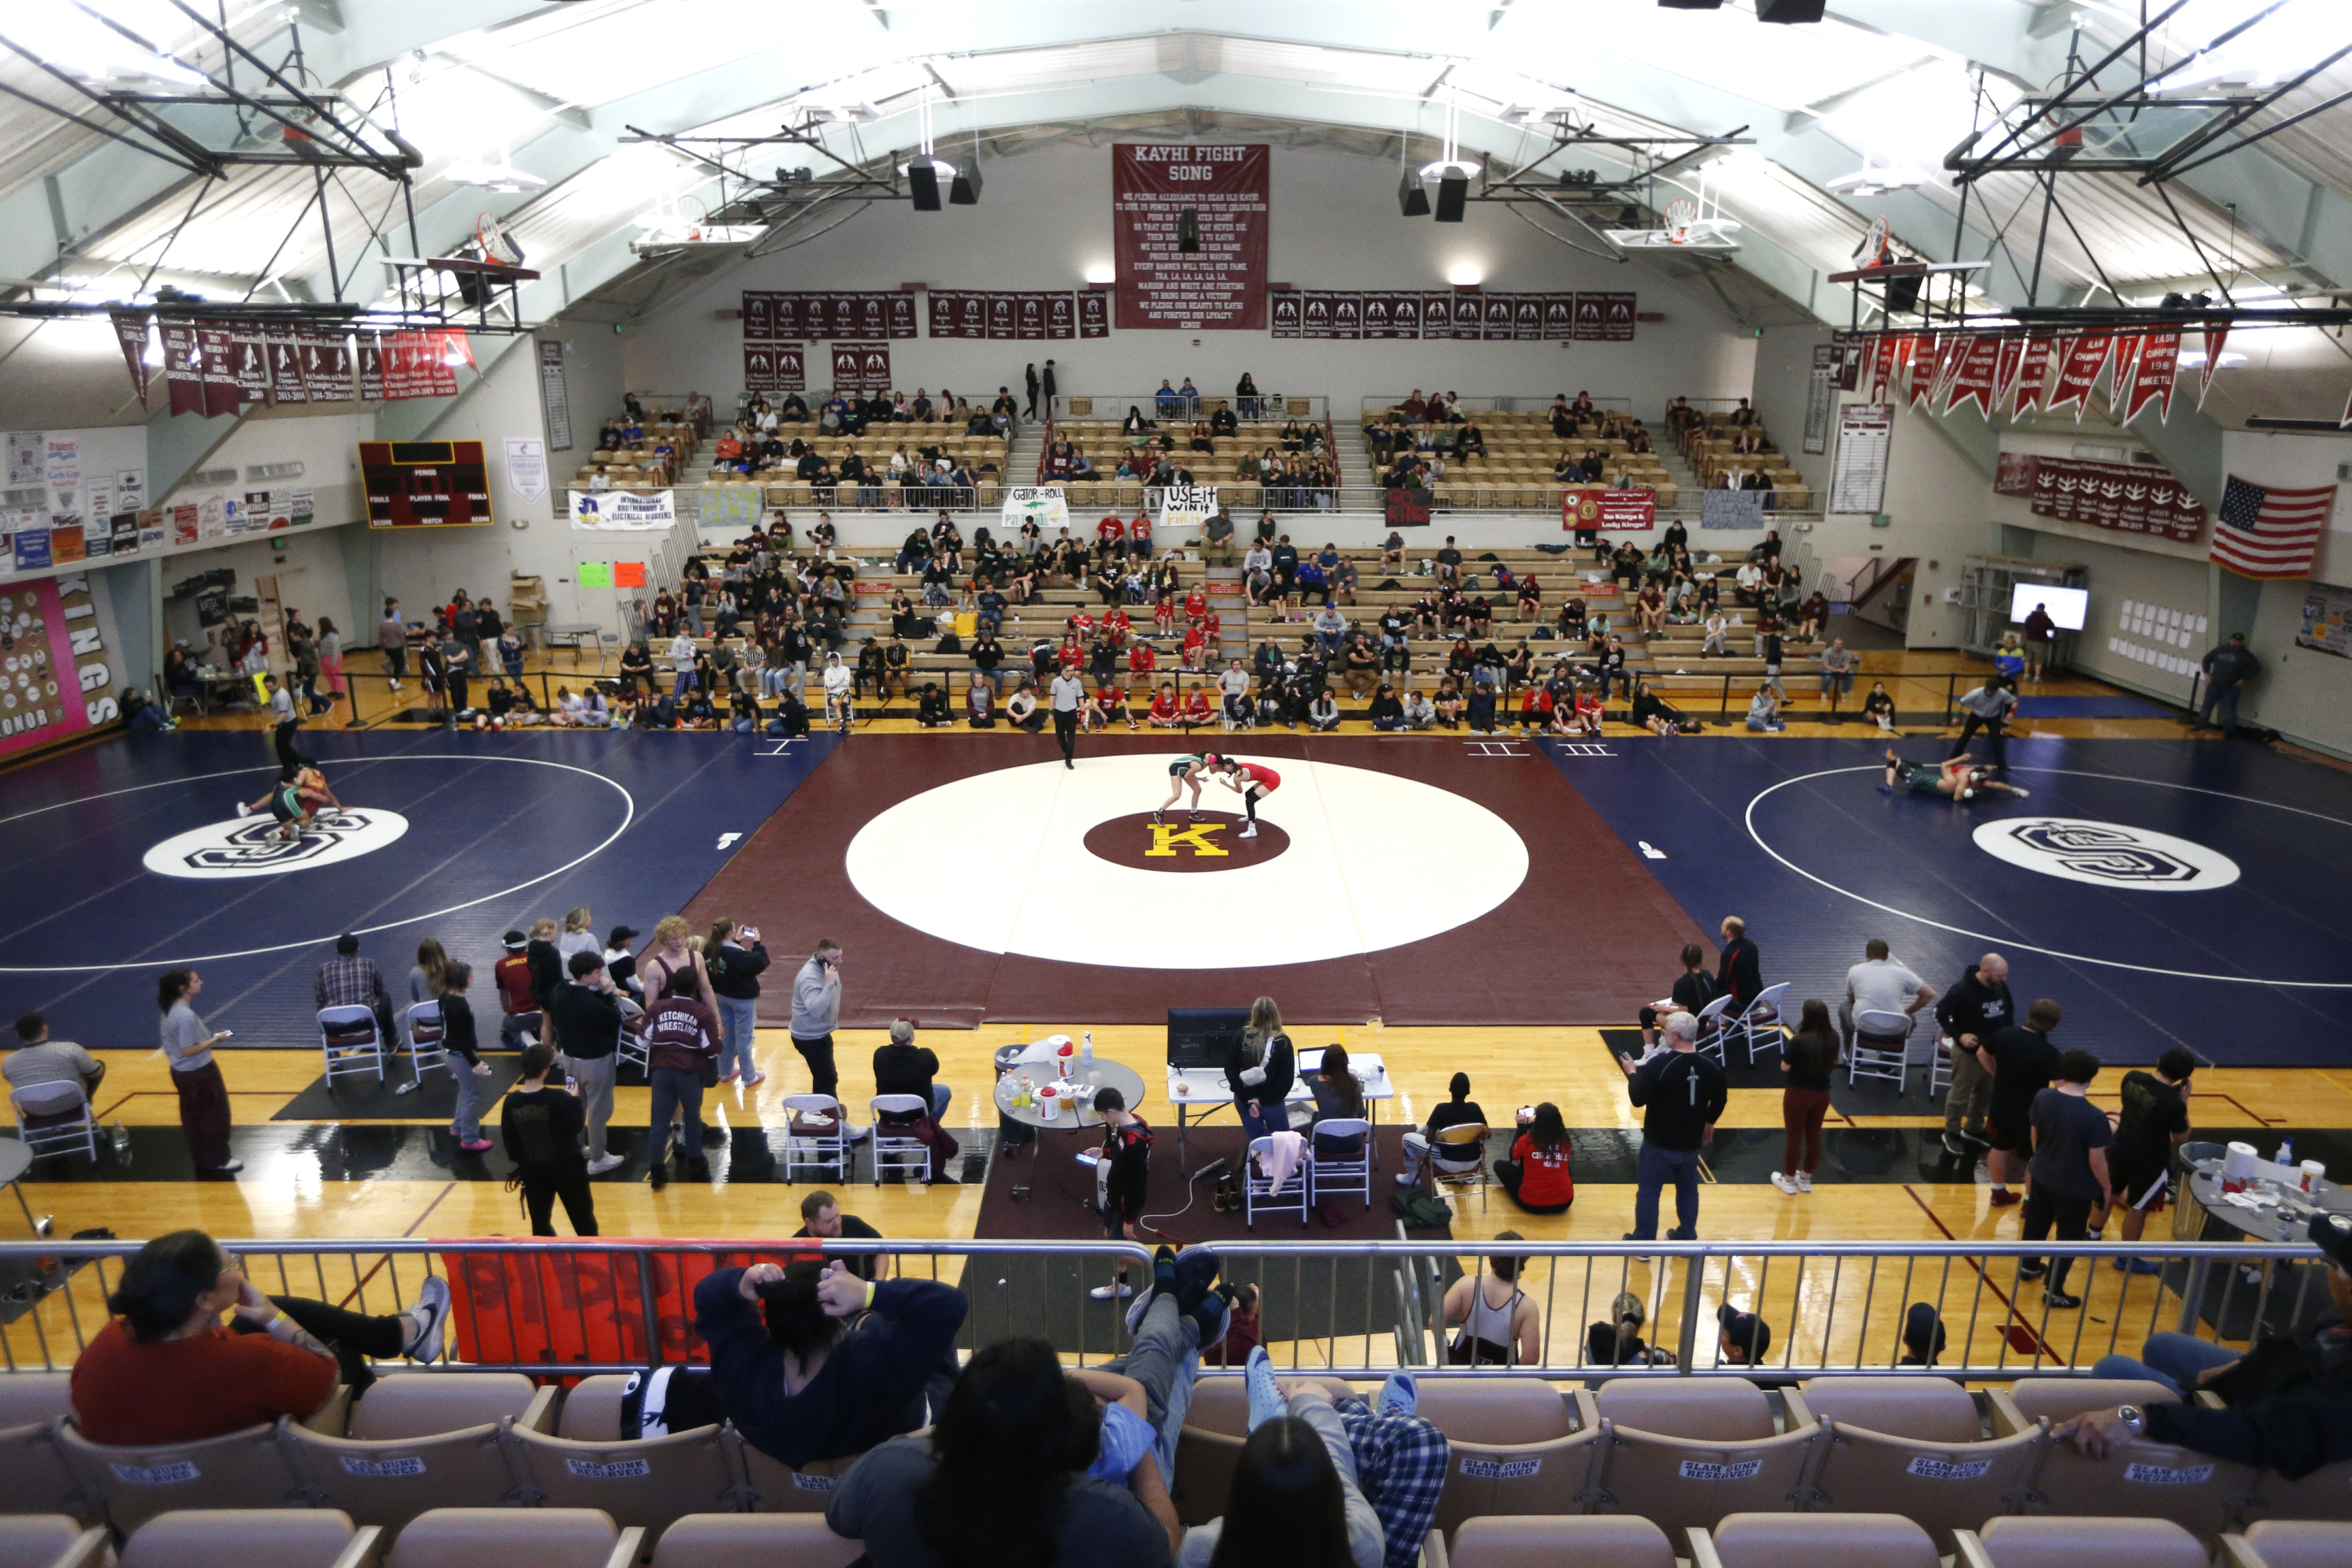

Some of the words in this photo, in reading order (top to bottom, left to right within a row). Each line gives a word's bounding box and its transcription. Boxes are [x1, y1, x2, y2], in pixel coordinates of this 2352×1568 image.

[1135, 146, 1190, 161] KAYHI
[1196, 146, 1246, 161] FIGHT
[1169, 166, 1213, 180] SONG
[123, 331, 146, 342] GIRLS
[1388, 489, 1414, 505] GO
[57, 578, 120, 726] KINGS
[1145, 823, 1229, 856] K
[659, 1011, 698, 1026] KETCHIKAN
[657, 1021, 698, 1036] WRESTLING
[381, 1458, 420, 1469] DUNK
[570, 1460, 602, 1471] SLAM
[608, 1460, 644, 1471] DUNK
[1465, 1460, 1499, 1470] SLAM
[1504, 1461, 1538, 1471] DUNK
[1686, 1462, 1722, 1472] SLAM
[1726, 1461, 1759, 1472] DUNK
[1916, 1459, 1953, 1471] SLAM
[1957, 1461, 1988, 1471] DUNK
[577, 1467, 642, 1478] RESERVED
[1467, 1467, 1533, 1477] RESERVED
[1686, 1469, 1753, 1479] RESERVED
[1915, 1467, 1980, 1478] RESERVED
[796, 1474, 828, 1484] SLAM
